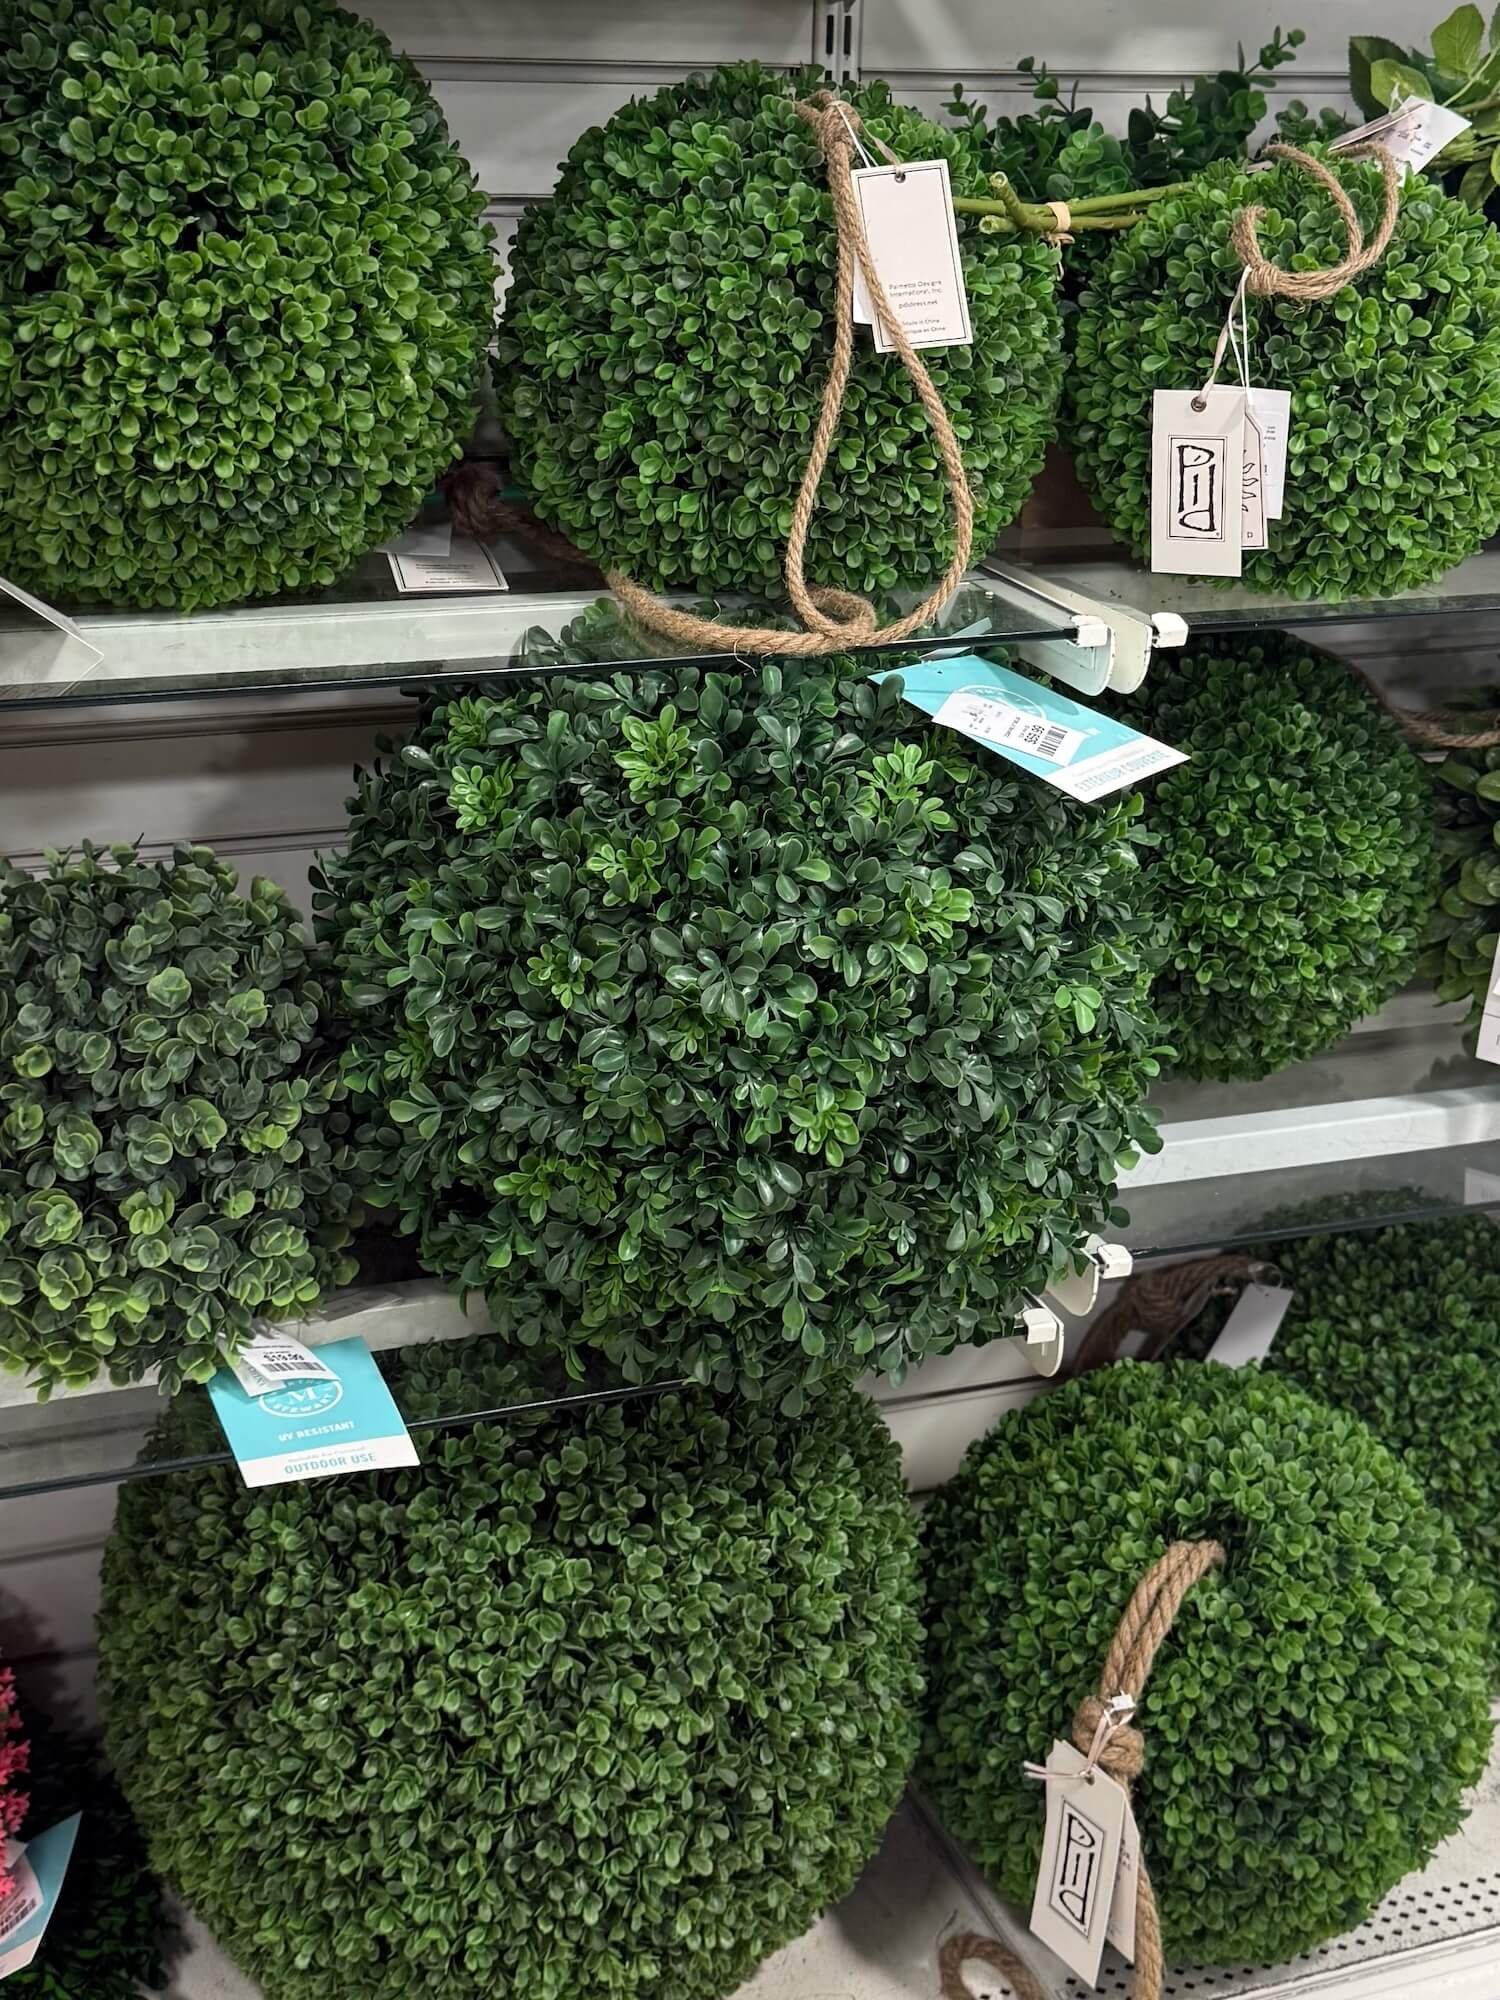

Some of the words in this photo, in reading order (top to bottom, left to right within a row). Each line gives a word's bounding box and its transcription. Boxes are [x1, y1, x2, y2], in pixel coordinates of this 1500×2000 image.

[278, 1432, 293, 1443] UV
[296, 1420, 355, 1438] RESISTANT
[284, 1456, 348, 1474] OUTDOOR
[350, 1452, 377, 1464] USE
